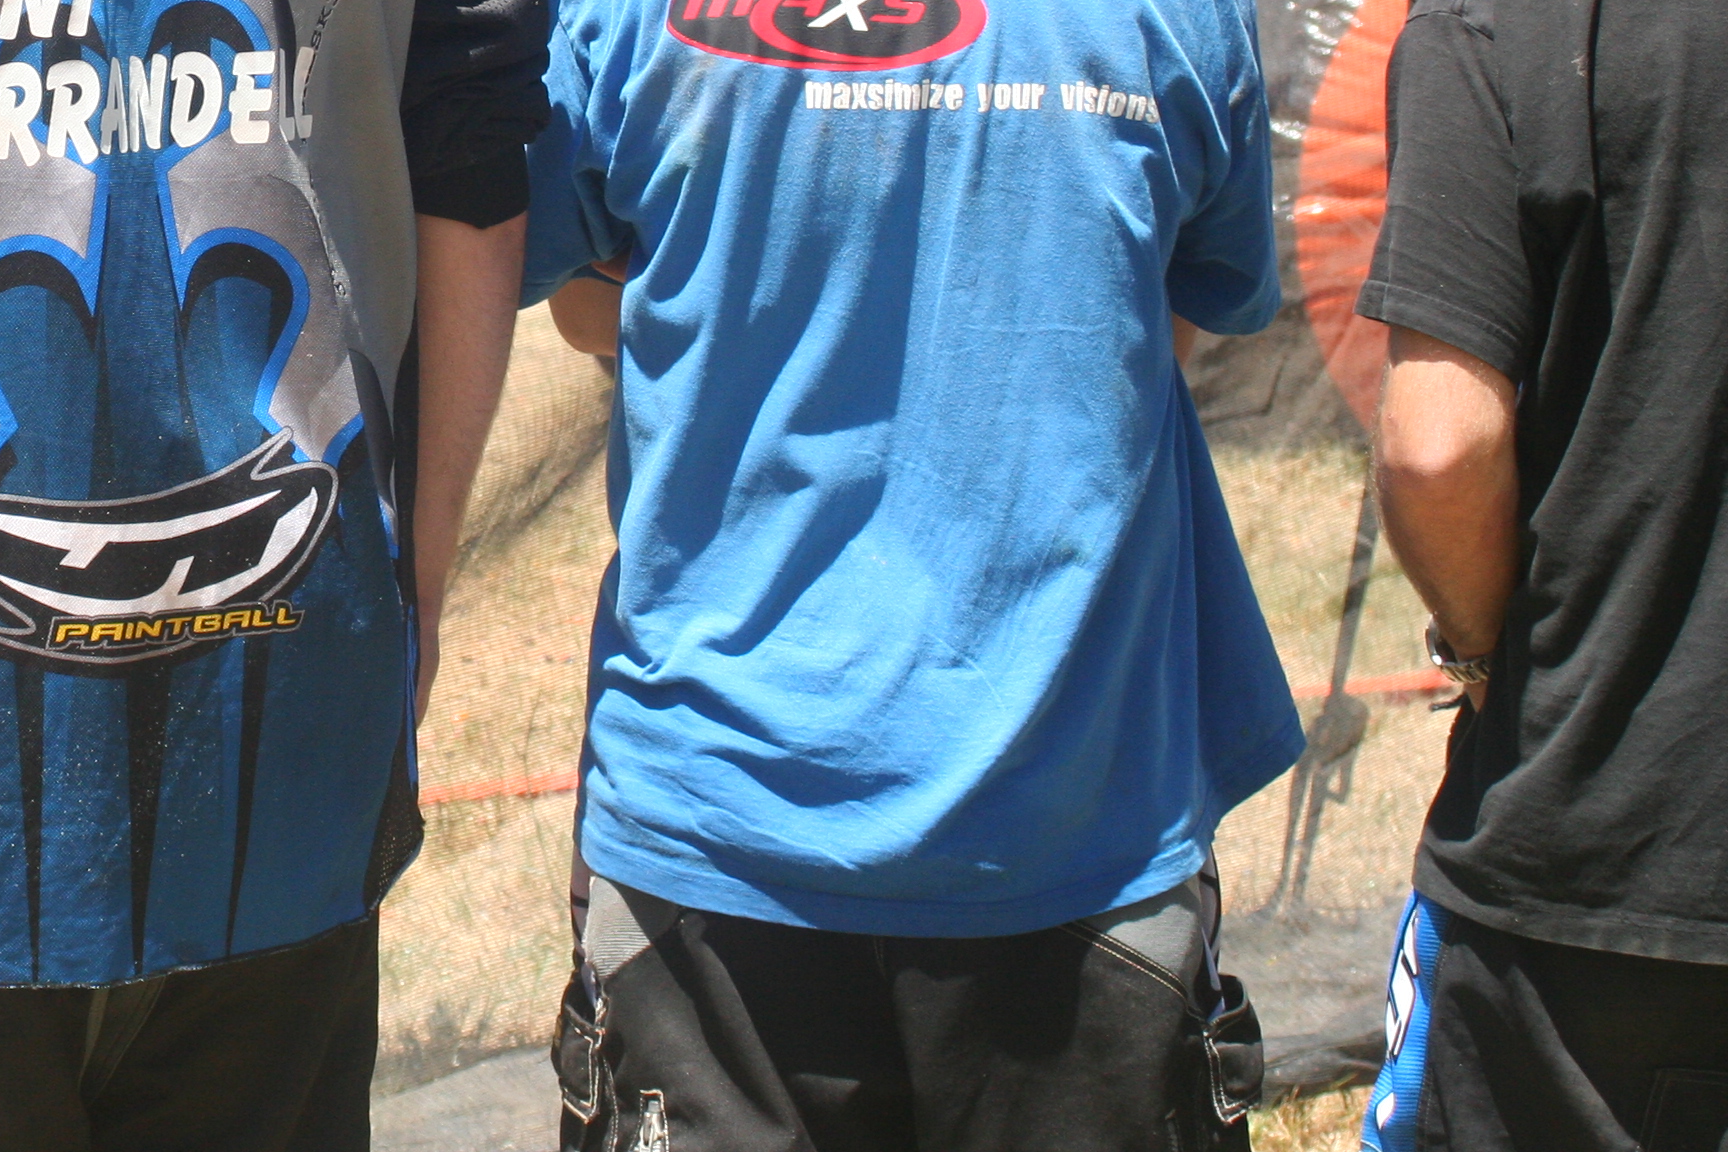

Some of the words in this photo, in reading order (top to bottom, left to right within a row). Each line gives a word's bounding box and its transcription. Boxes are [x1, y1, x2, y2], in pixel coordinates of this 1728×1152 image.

[805, 79, 964, 110] maxsimize
[977, 82, 1046, 112] your
[1061, 80, 1160, 123] visions
[54, 606, 300, 644] PAINTBALL
